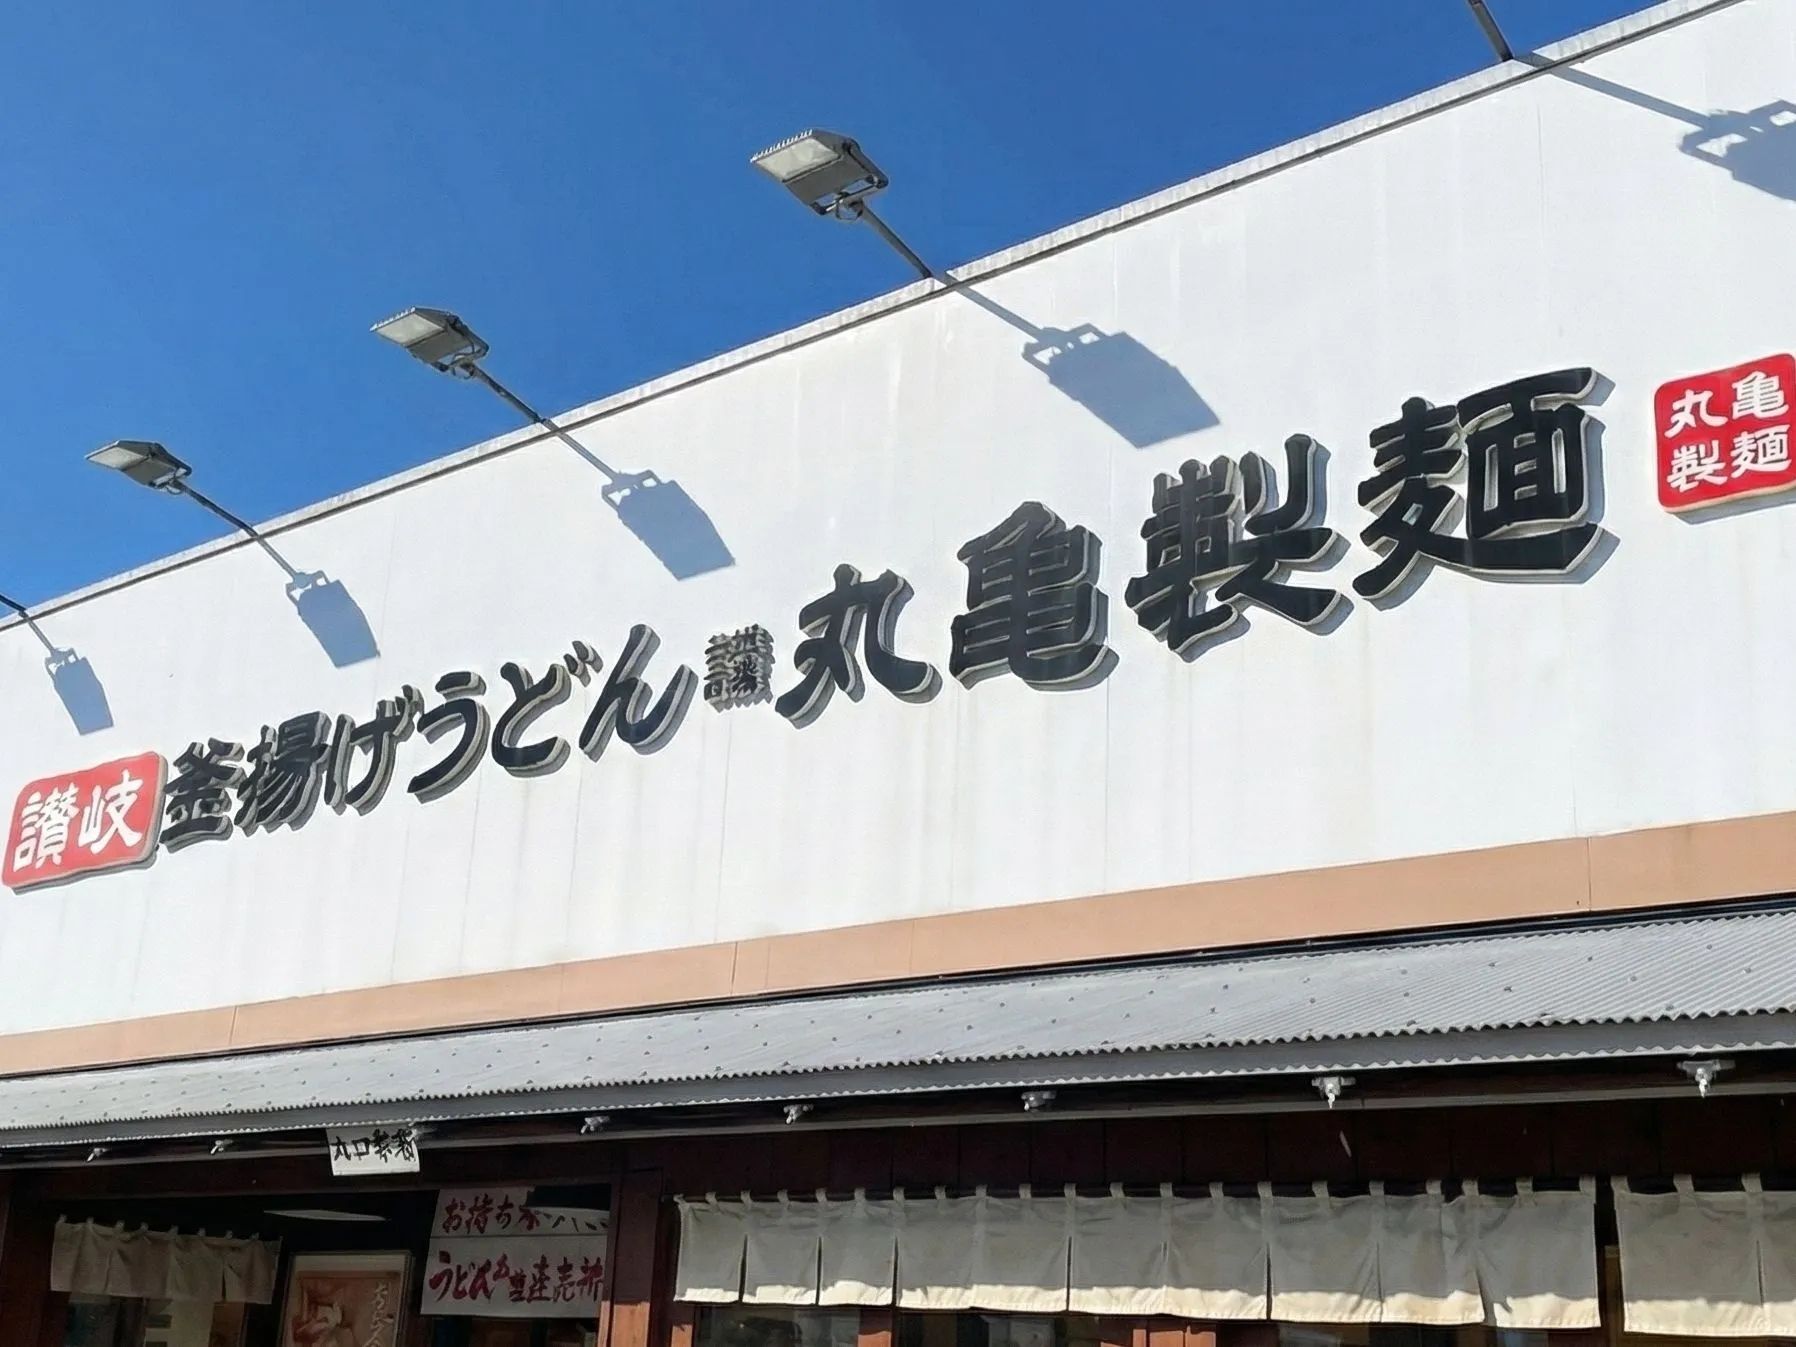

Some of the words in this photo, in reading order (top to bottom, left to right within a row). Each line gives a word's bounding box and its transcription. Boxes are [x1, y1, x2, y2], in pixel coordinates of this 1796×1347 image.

[774, 366, 1608, 729] 丸亀製麺
[159, 623, 696, 852] 釜揚げうどん
